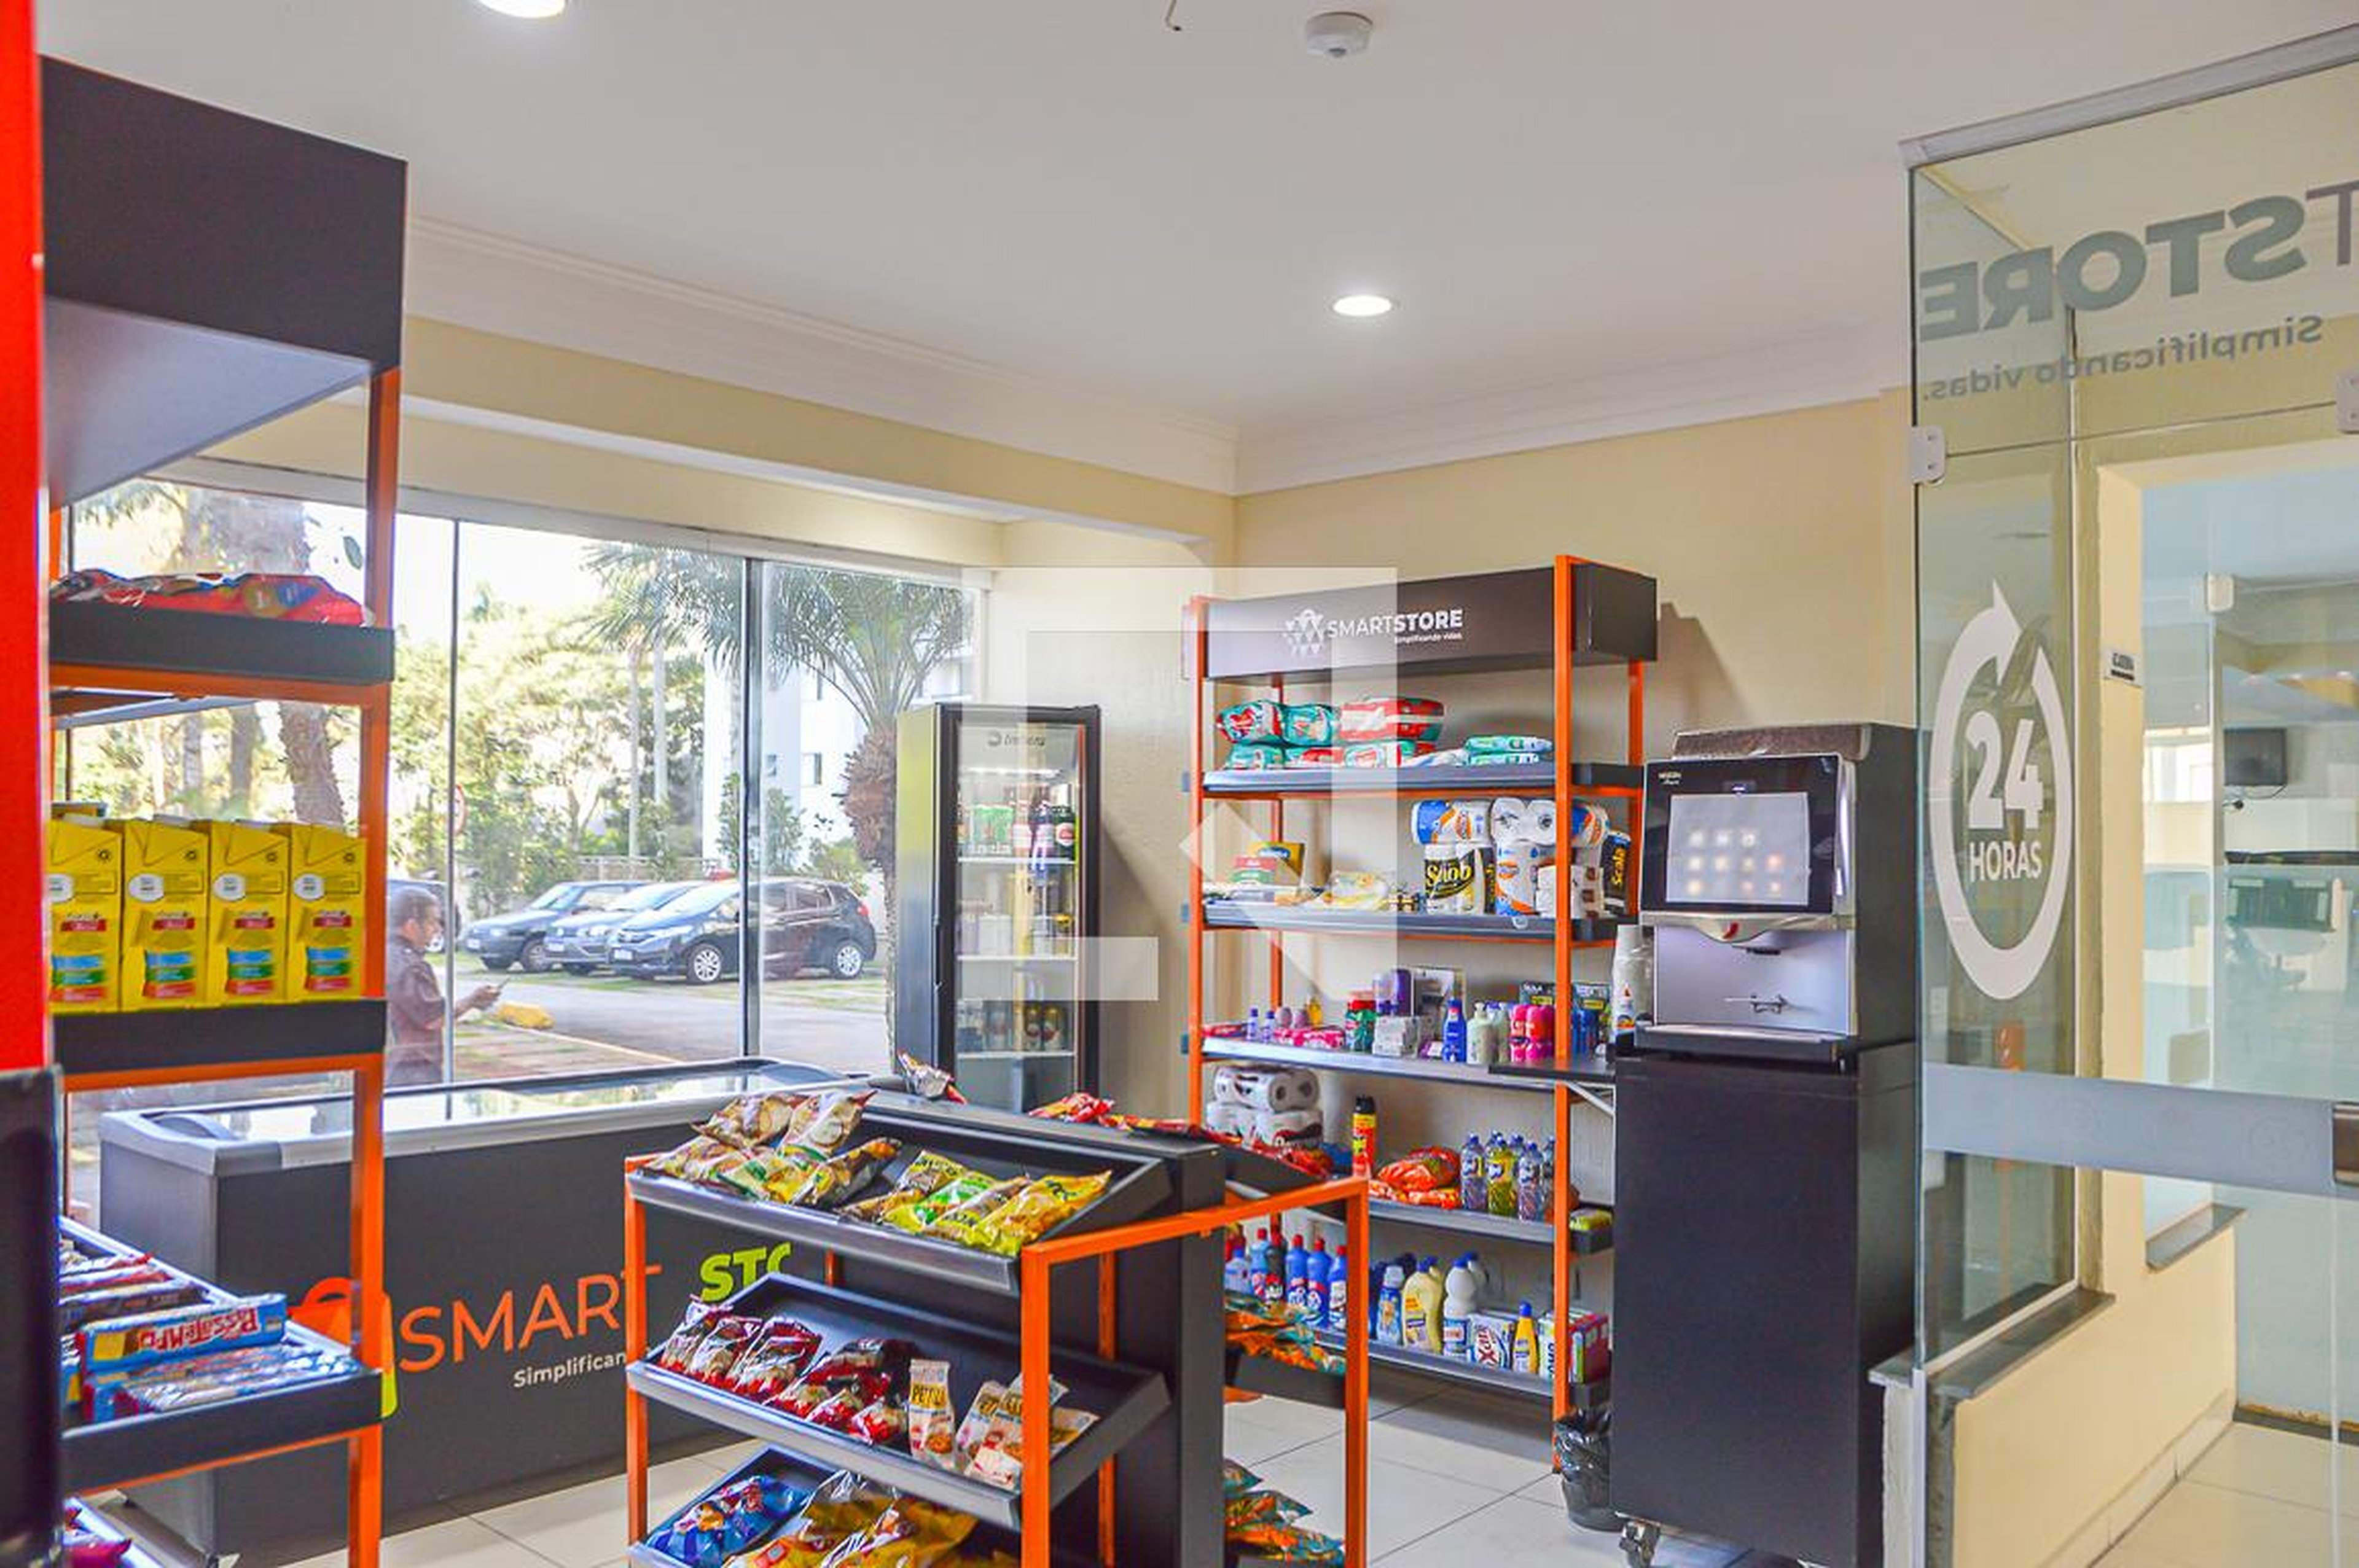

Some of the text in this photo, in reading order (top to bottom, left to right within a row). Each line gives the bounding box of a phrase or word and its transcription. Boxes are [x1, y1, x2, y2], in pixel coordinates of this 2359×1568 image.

[1327, 608, 1463, 639] SMARTSTORE
[1967, 710, 2044, 829] 24
[1969, 840, 2042, 883] HORAS
[398, 1263, 662, 1373] SMAR
[513, 1351, 626, 1388] Simplifican
